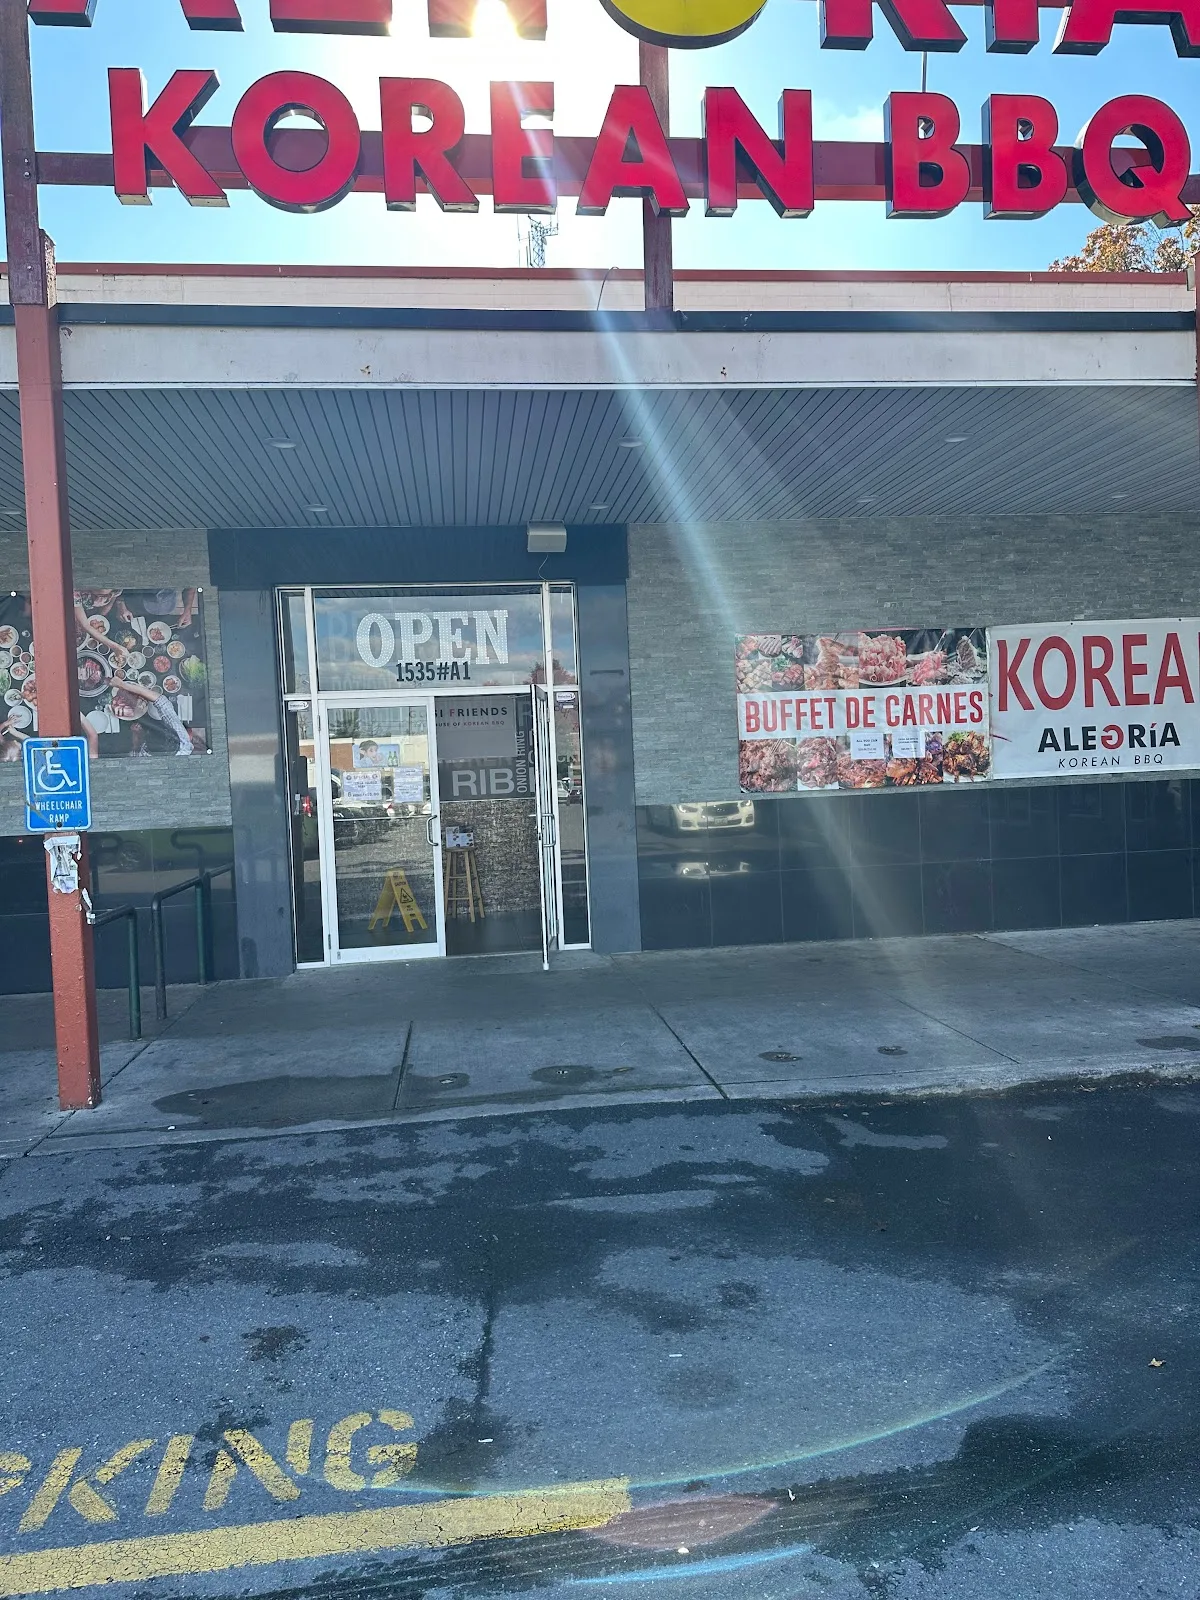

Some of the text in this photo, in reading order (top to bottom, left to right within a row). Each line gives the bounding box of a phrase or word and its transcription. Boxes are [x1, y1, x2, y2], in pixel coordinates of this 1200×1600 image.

[108, 67, 1194, 227] KOREAN BBQ
[356, 609, 509, 668] OPEN
[396, 660, 471, 682] 1535#A1
[996, 632, 1200, 711] KOREA
[449, 706, 508, 718] FRIENDS
[745, 690, 983, 733] BUFFET DE CARNES
[515, 730, 528, 793] ONION RING
[1058, 753, 1163, 768] KOREAN BBQ
[451, 768, 515, 797] RIB
[35, 800, 83, 811] WHEELCHAIR
[49, 813, 70, 823] RAMP
